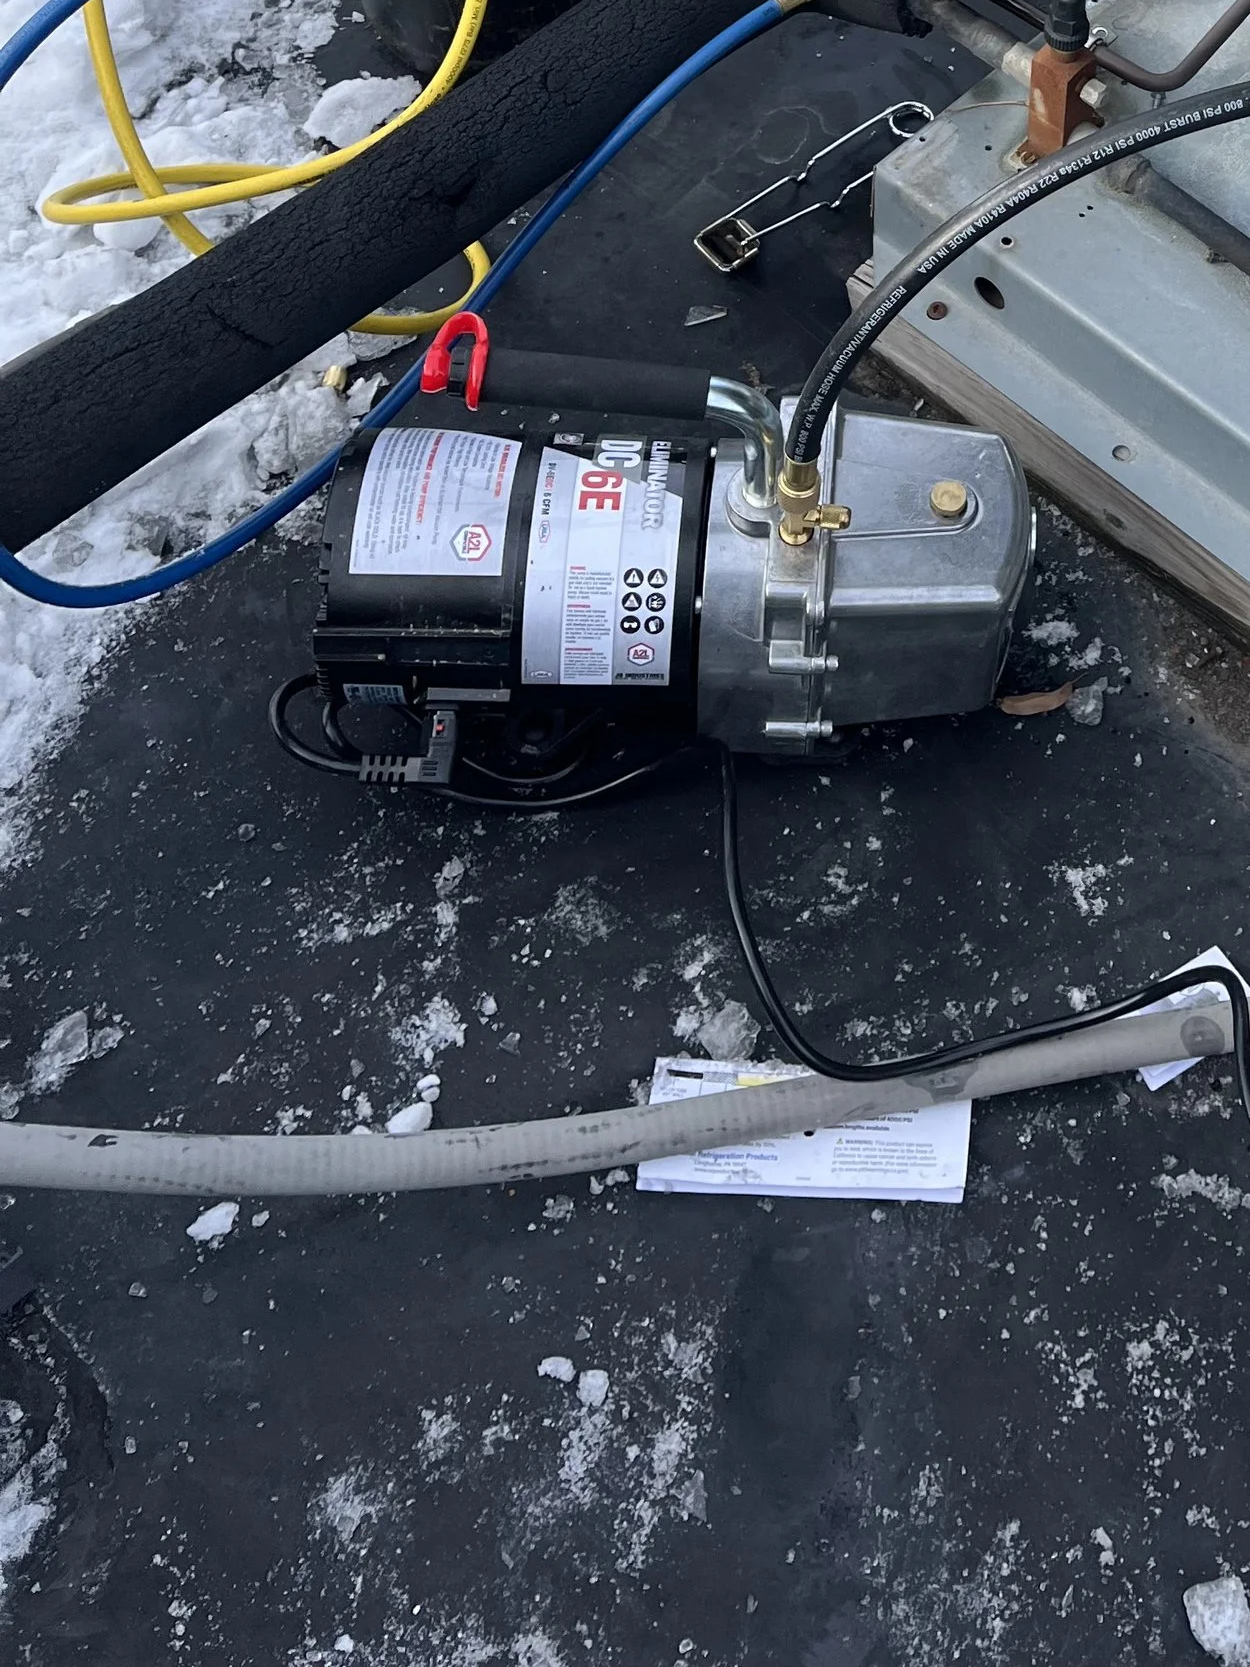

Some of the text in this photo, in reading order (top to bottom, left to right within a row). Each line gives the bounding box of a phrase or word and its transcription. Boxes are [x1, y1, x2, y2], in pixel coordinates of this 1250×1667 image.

[1203, 105, 1222, 119] PSI
[1224, 99, 1244, 113] 800
[1163, 110, 1201, 132] BURST
[1135, 126, 1162, 141] 4000
[1115, 135, 1134, 150] PSI
[1092, 144, 1114, 161] R12
[1058, 154, 1092, 177] R134a
[1037, 169, 1059, 186] R22
[1005, 182, 1040, 208] R404A
[973, 202, 1007, 228] R410A
[947, 224, 976, 251] MADE
[936, 247, 948, 261] IN
[916, 255, 939, 274] USA
[831, 286, 907, 375] REFRIGERANT/VACUUM
[820, 369, 840, 394] HOSE
[798, 430, 808, 443] 800
[794, 442, 805, 455] PSI
[641, 441, 670, 530] ELIMINATOR
[541, 498, 550, 515] CFM
[466, 531, 481, 553] A2L
[696, 1151, 778, 1162] Refrigeration Products
